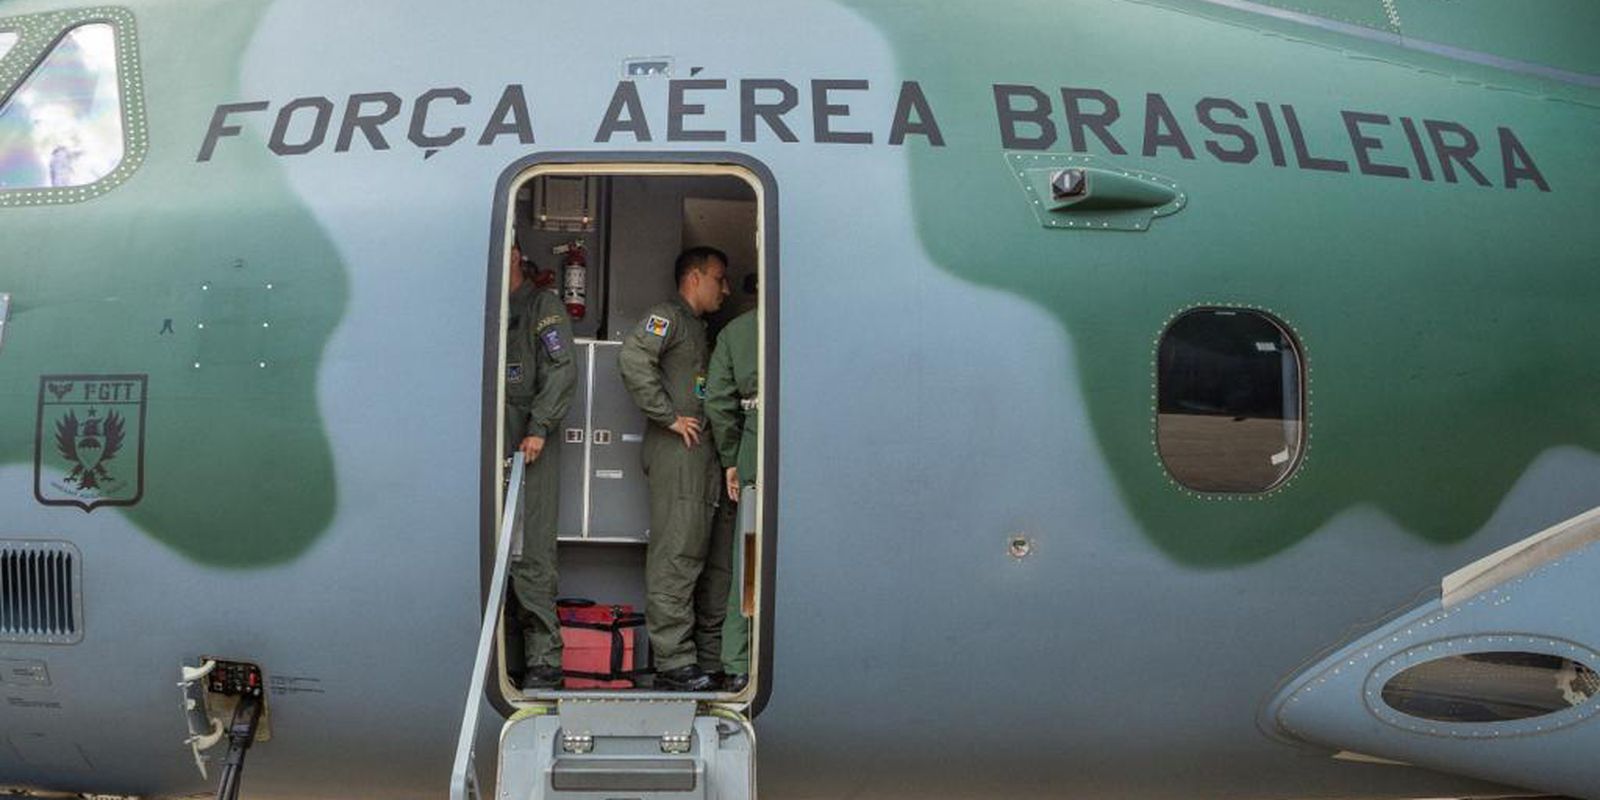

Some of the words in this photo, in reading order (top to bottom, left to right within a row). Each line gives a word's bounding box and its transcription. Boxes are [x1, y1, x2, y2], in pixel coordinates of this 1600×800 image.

[197, 84, 536, 162] FORÇA
[593, 67, 946, 147] AÉREA
[992, 84, 1552, 193] BRASILEIRA
